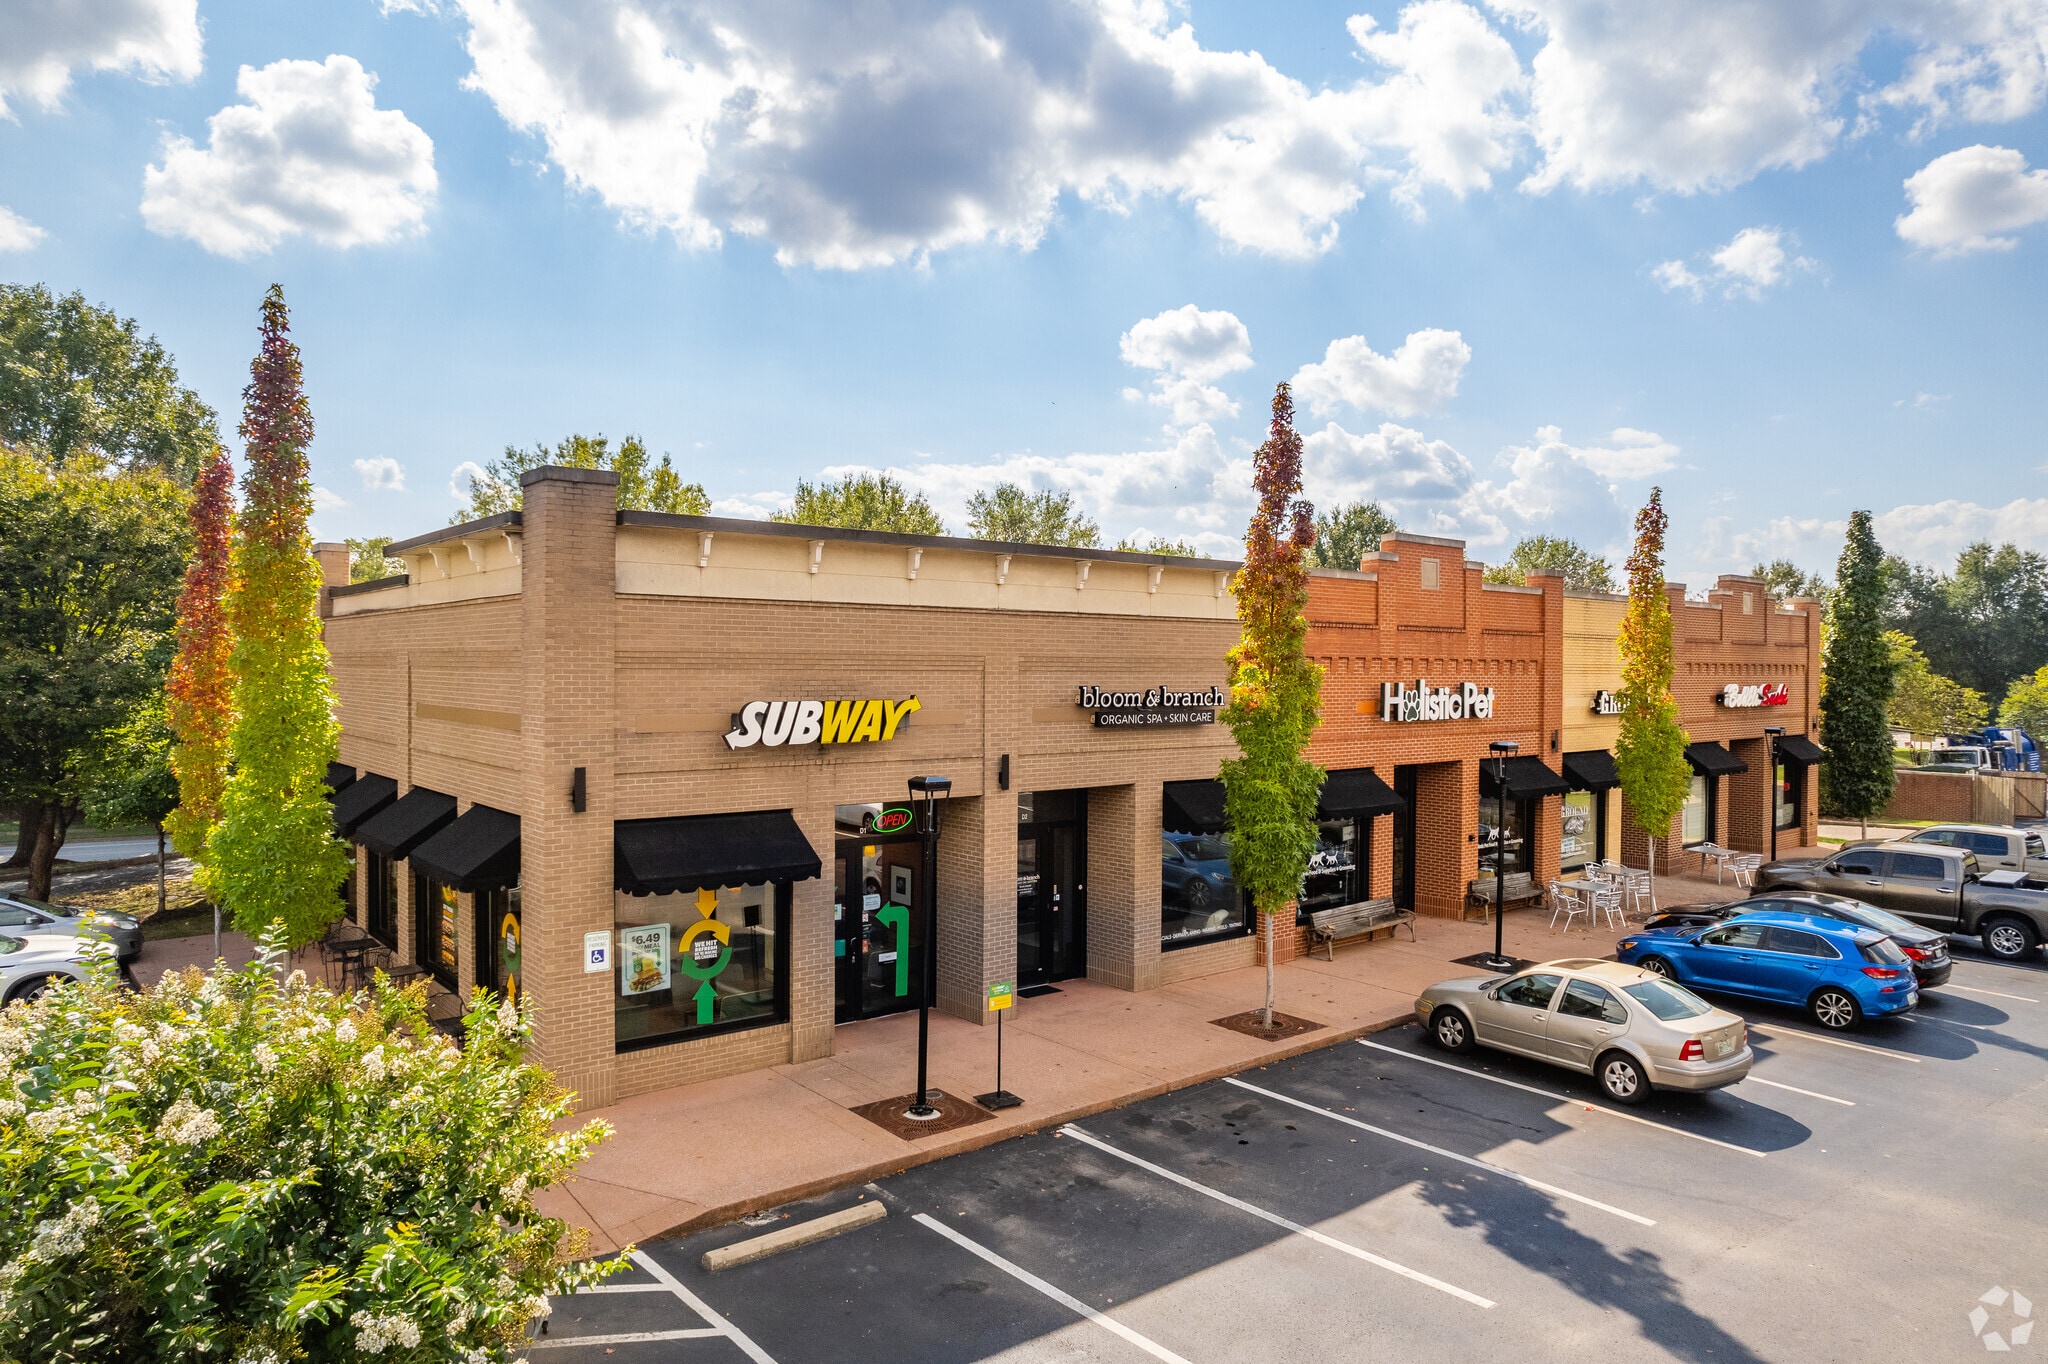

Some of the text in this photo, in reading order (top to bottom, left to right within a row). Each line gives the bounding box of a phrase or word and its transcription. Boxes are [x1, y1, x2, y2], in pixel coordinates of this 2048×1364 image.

[1081, 685, 1225, 708] bloom & branch
[1463, 682, 1495, 719] Pet
[723, 695, 922, 750] SUBWAY
[1100, 712, 1212, 725] ORGANIC SPA SKIN CARE
[877, 813, 908, 828] OPEN
[631, 932, 661, 945] $6.49
[705, 939, 718, 947] HIT
